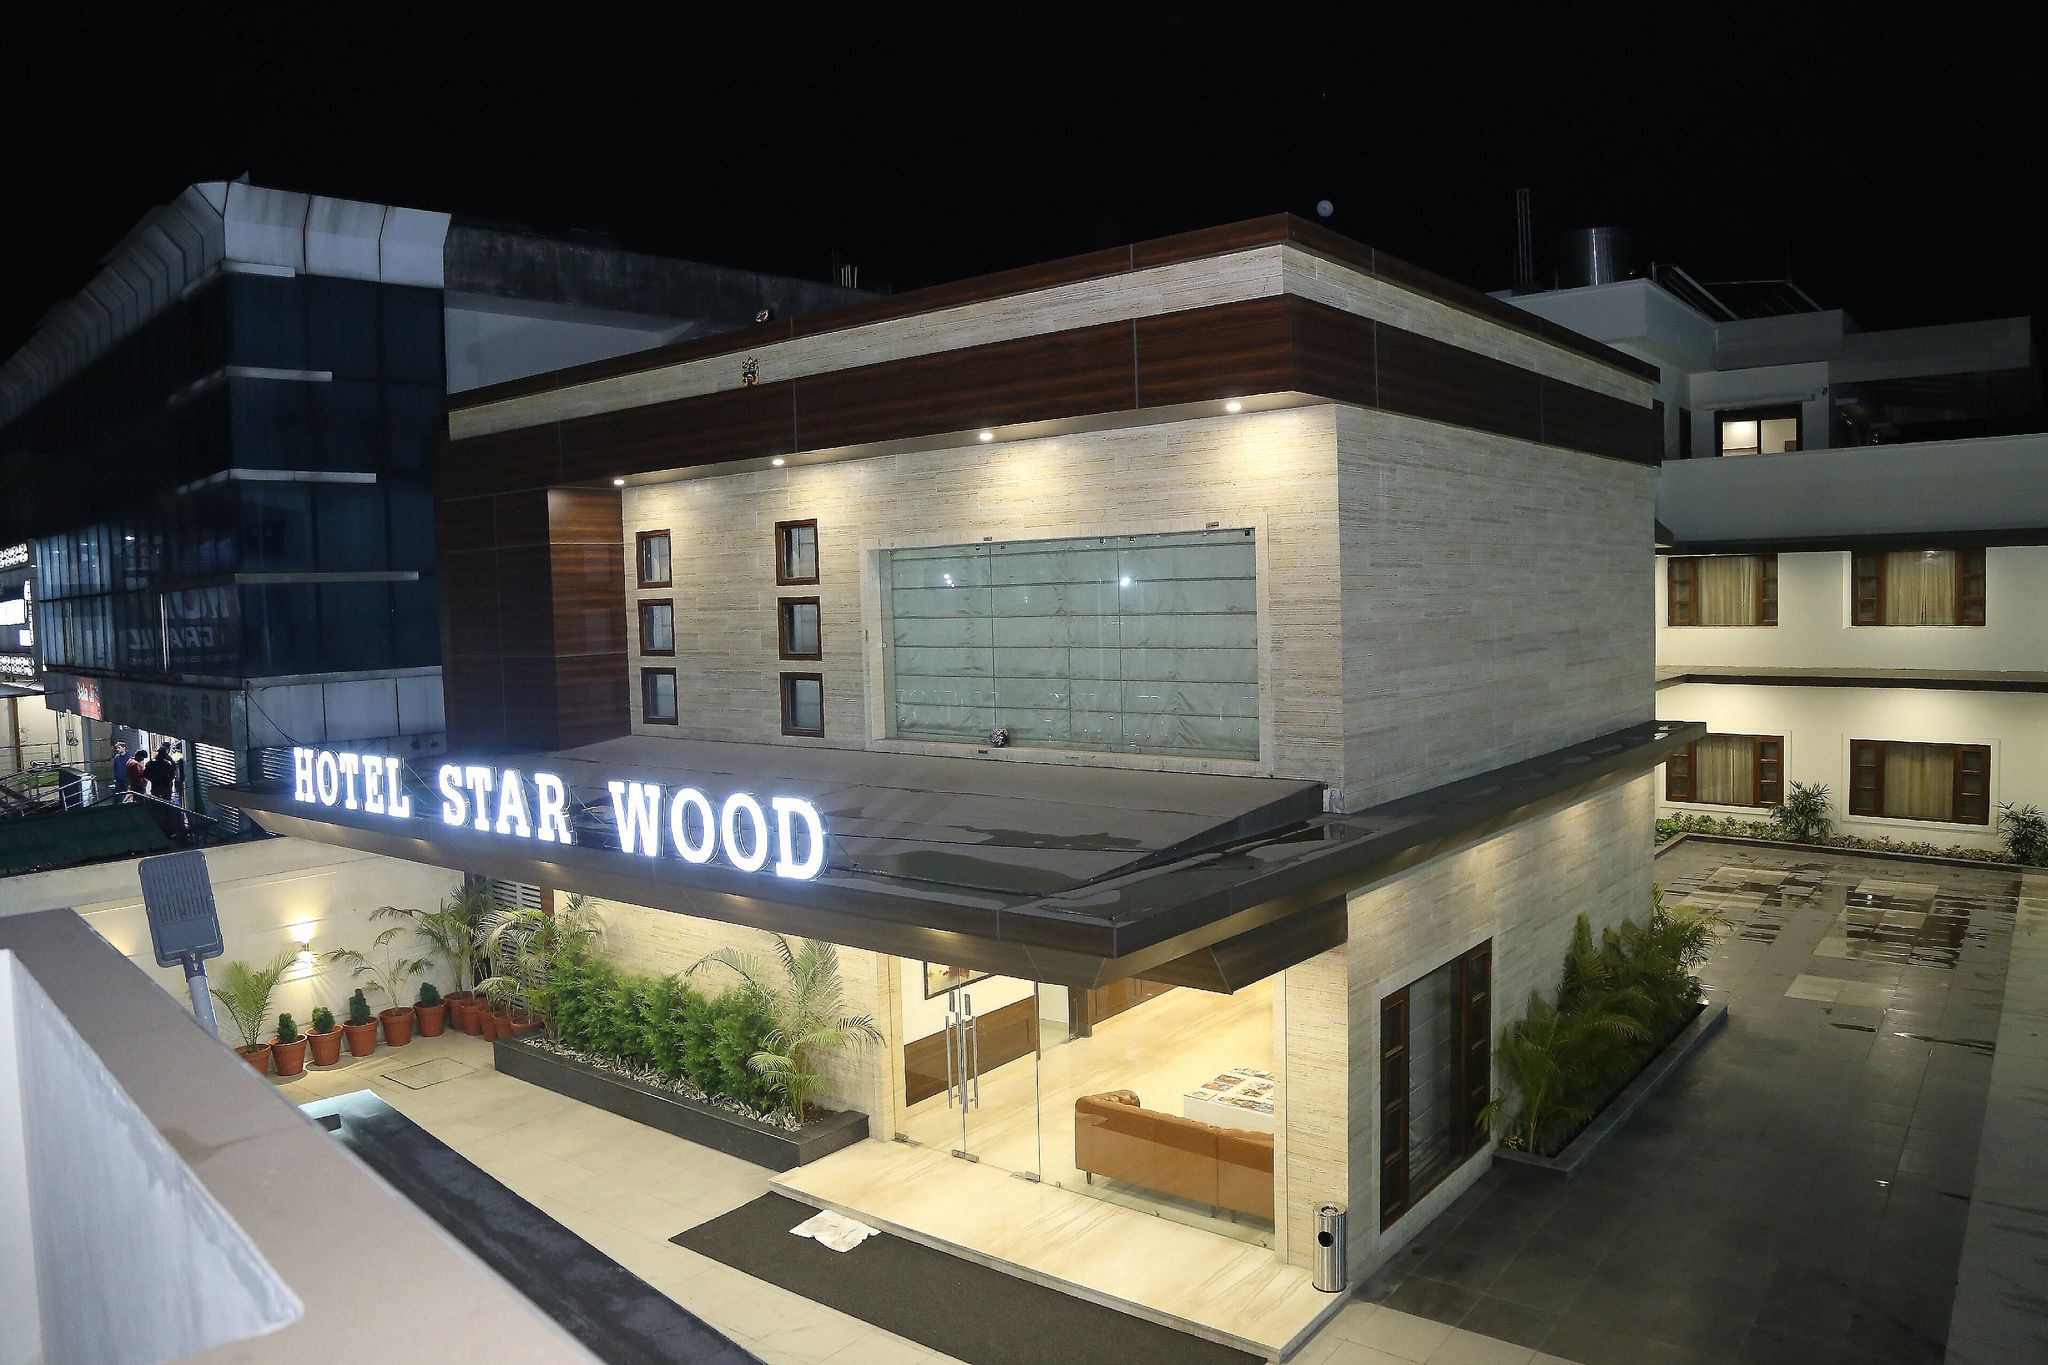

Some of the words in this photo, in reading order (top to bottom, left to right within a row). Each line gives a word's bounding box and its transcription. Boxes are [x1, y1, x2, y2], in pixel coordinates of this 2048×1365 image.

[293, 746, 411, 818] HOTEL
[438, 763, 577, 845] STAR
[608, 780, 828, 881] WOOD
